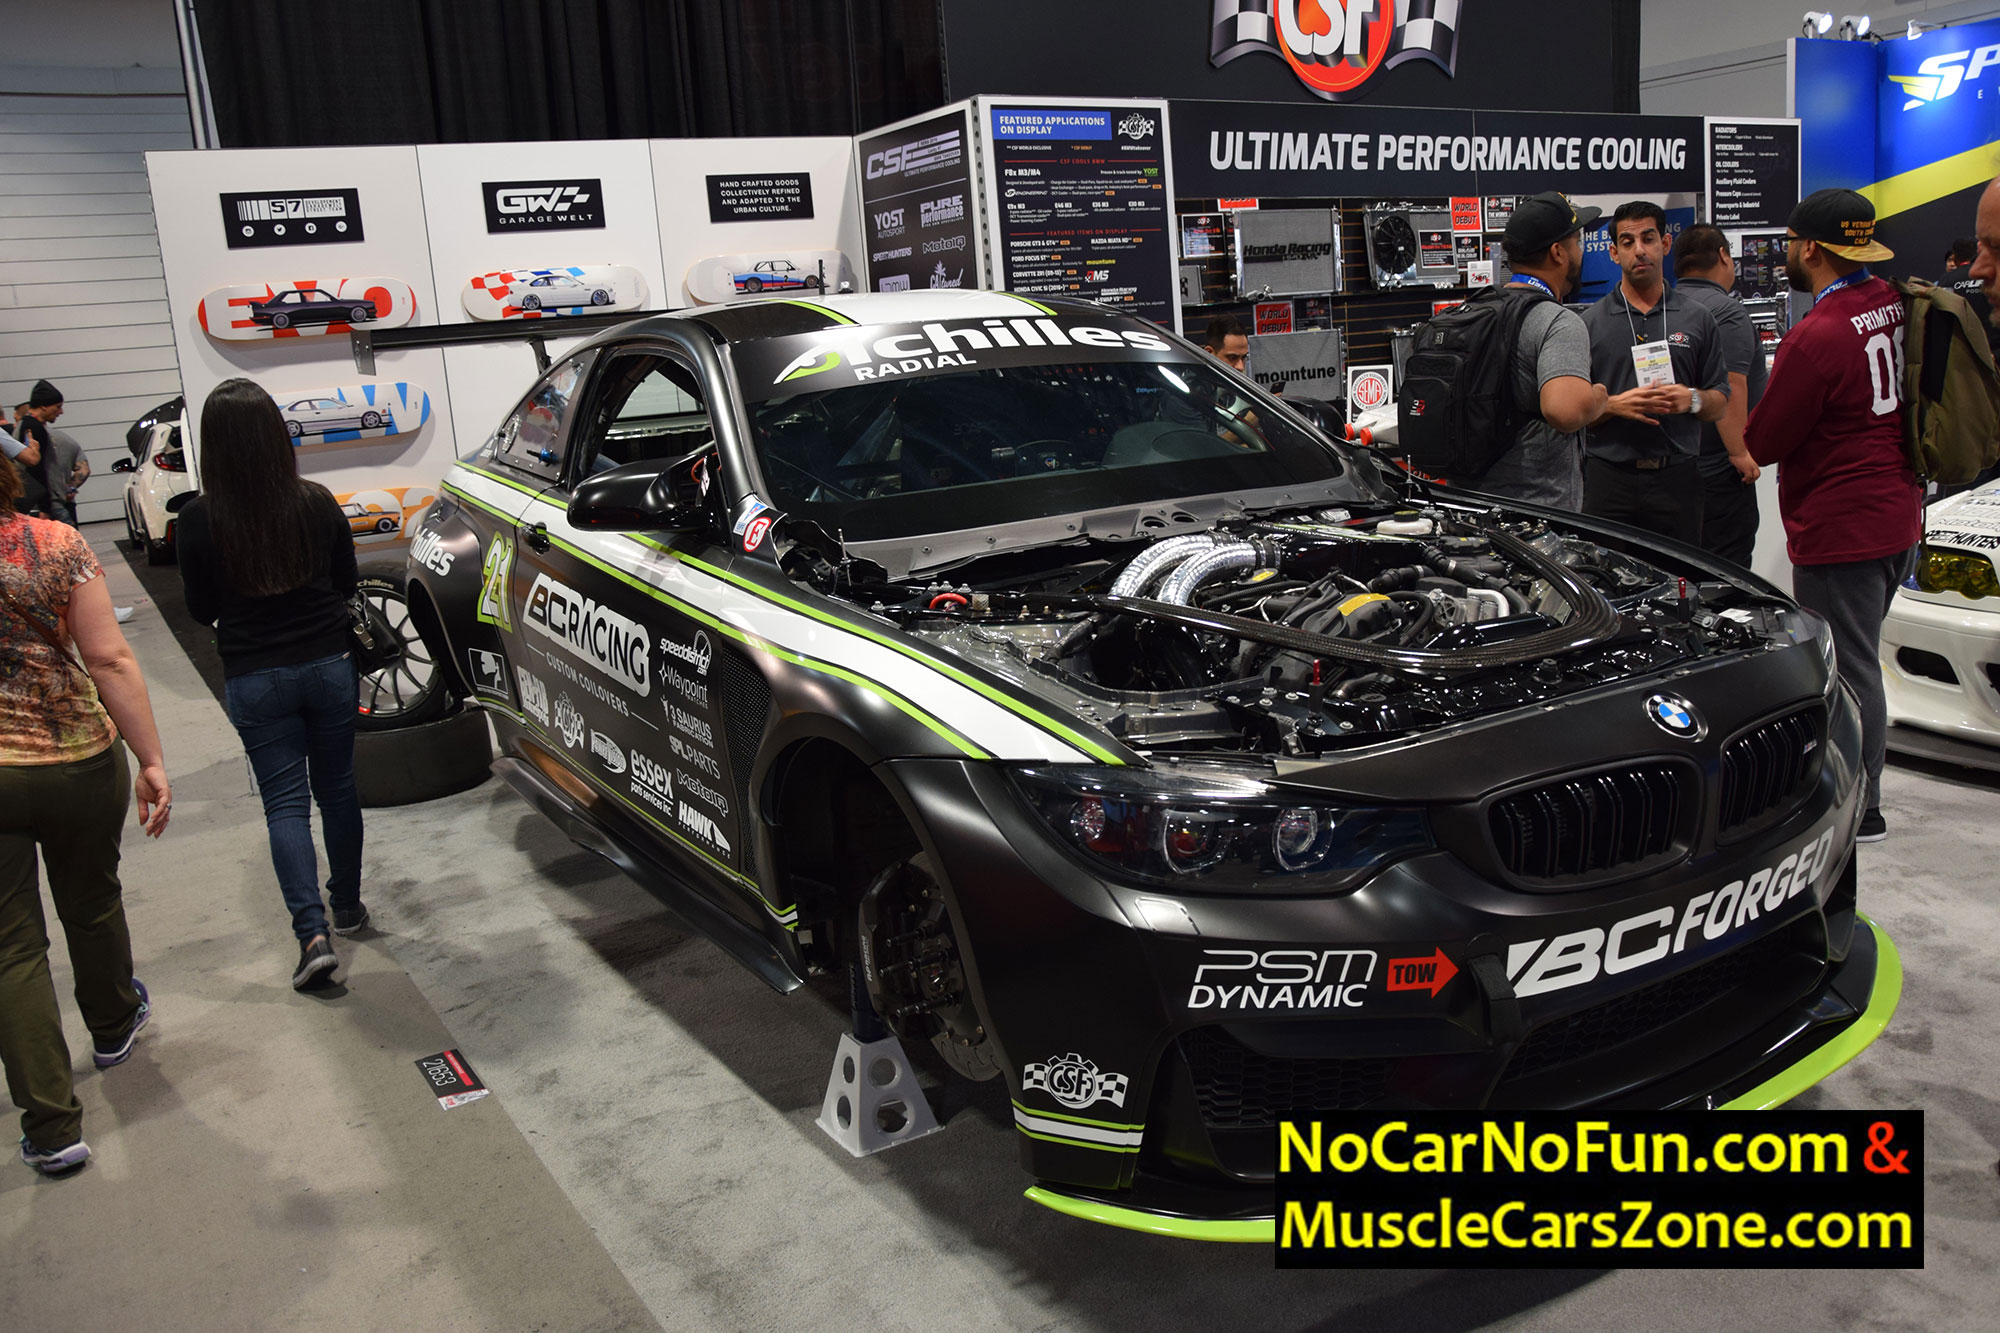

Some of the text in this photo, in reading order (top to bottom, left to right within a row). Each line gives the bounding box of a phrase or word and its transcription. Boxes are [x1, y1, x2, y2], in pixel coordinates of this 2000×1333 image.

[1000, 115, 1105, 126] FEATURED APPLICATIONS
[1000, 126, 1052, 135] ON DISPLAY
[1210, 131, 1687, 171] ULTIMATE PERFORMANCE COOLING
[719, 179, 800, 188] HAND CRAFTED GOODS
[720, 187, 801, 197] COLLECTIVELY REFINED
[721, 198, 738, 206] AND
[739, 197, 773, 205] ADAPTED
[787, 196, 802, 204] THE
[733, 205, 792, 214] URBAN CULTURE.
[920, 195, 963, 213] PURE
[1454, 203, 1478, 212] WORLD
[499, 213, 594, 226] GARAGE WELT
[874, 208, 904, 231] YOST
[920, 205, 964, 228] performance
[1455, 215, 1477, 225] DEBUT
[877, 226, 905, 239] AUTOSPORT
[1243, 242, 1332, 256] Honda Racing
[1258, 310, 1289, 321] WORLD
[1260, 323, 1288, 334] DEBUT
[773, 318, 1172, 385] Achilles
[853, 352, 977, 382] RADIAL
[1255, 365, 1337, 385] mountune
[1357, 378, 1382, 404] SEMA
[660, 637, 710, 669] speeddistrict
[547, 651, 579, 685] CUSTOM
[578, 672, 629, 717] COILOVERS
[667, 664, 708, 703] Waypoint
[672, 720, 714, 749] FABRICATION
[676, 707, 713, 741] SAURUS
[630, 749, 674, 800] essex
[631, 781, 643, 796] parts
[642, 790, 663, 811] services
[679, 800, 713, 842] HAWK
[1194, 949, 1378, 984] PSM
[1393, 962, 1438, 985] TOW
[1187, 984, 1369, 1009] DYNAMIC
[1049, 1064, 1096, 1096] CSF
